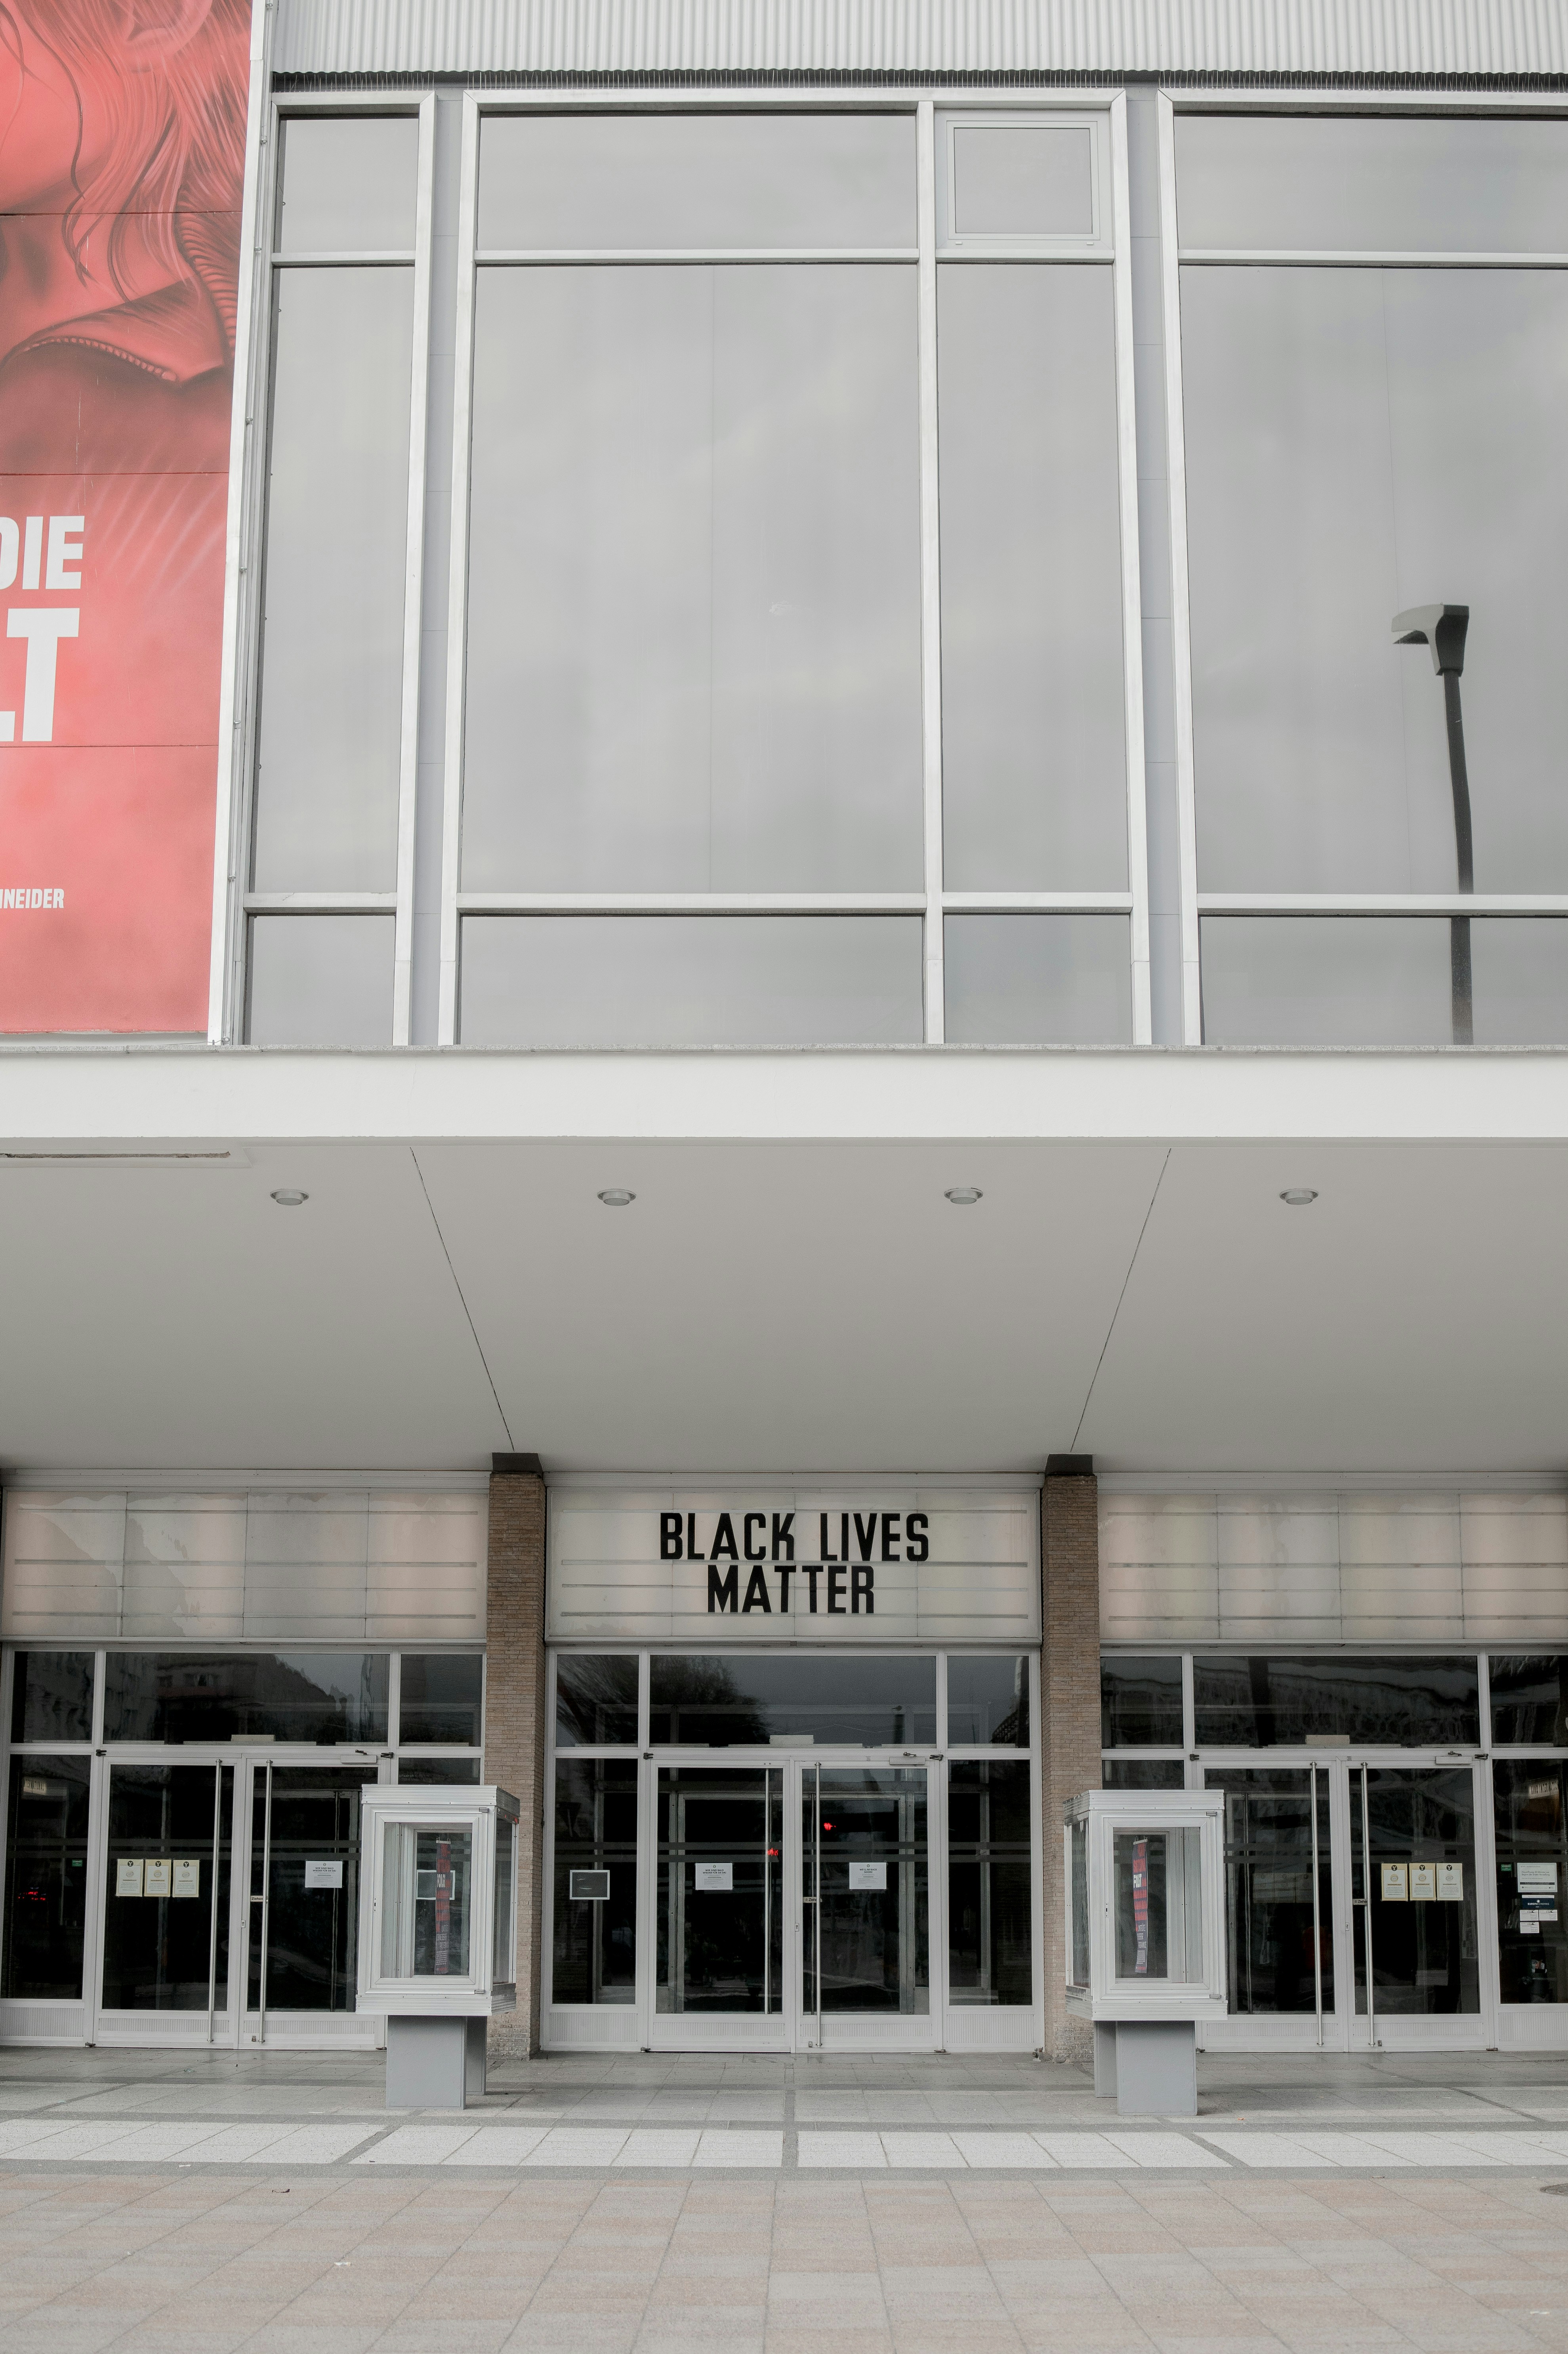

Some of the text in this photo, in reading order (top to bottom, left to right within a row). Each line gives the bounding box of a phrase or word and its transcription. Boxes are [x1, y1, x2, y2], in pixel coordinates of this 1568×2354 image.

[660, 1513, 929, 1562] BLACK LIVES
[708, 1564, 874, 1614] MATTER
